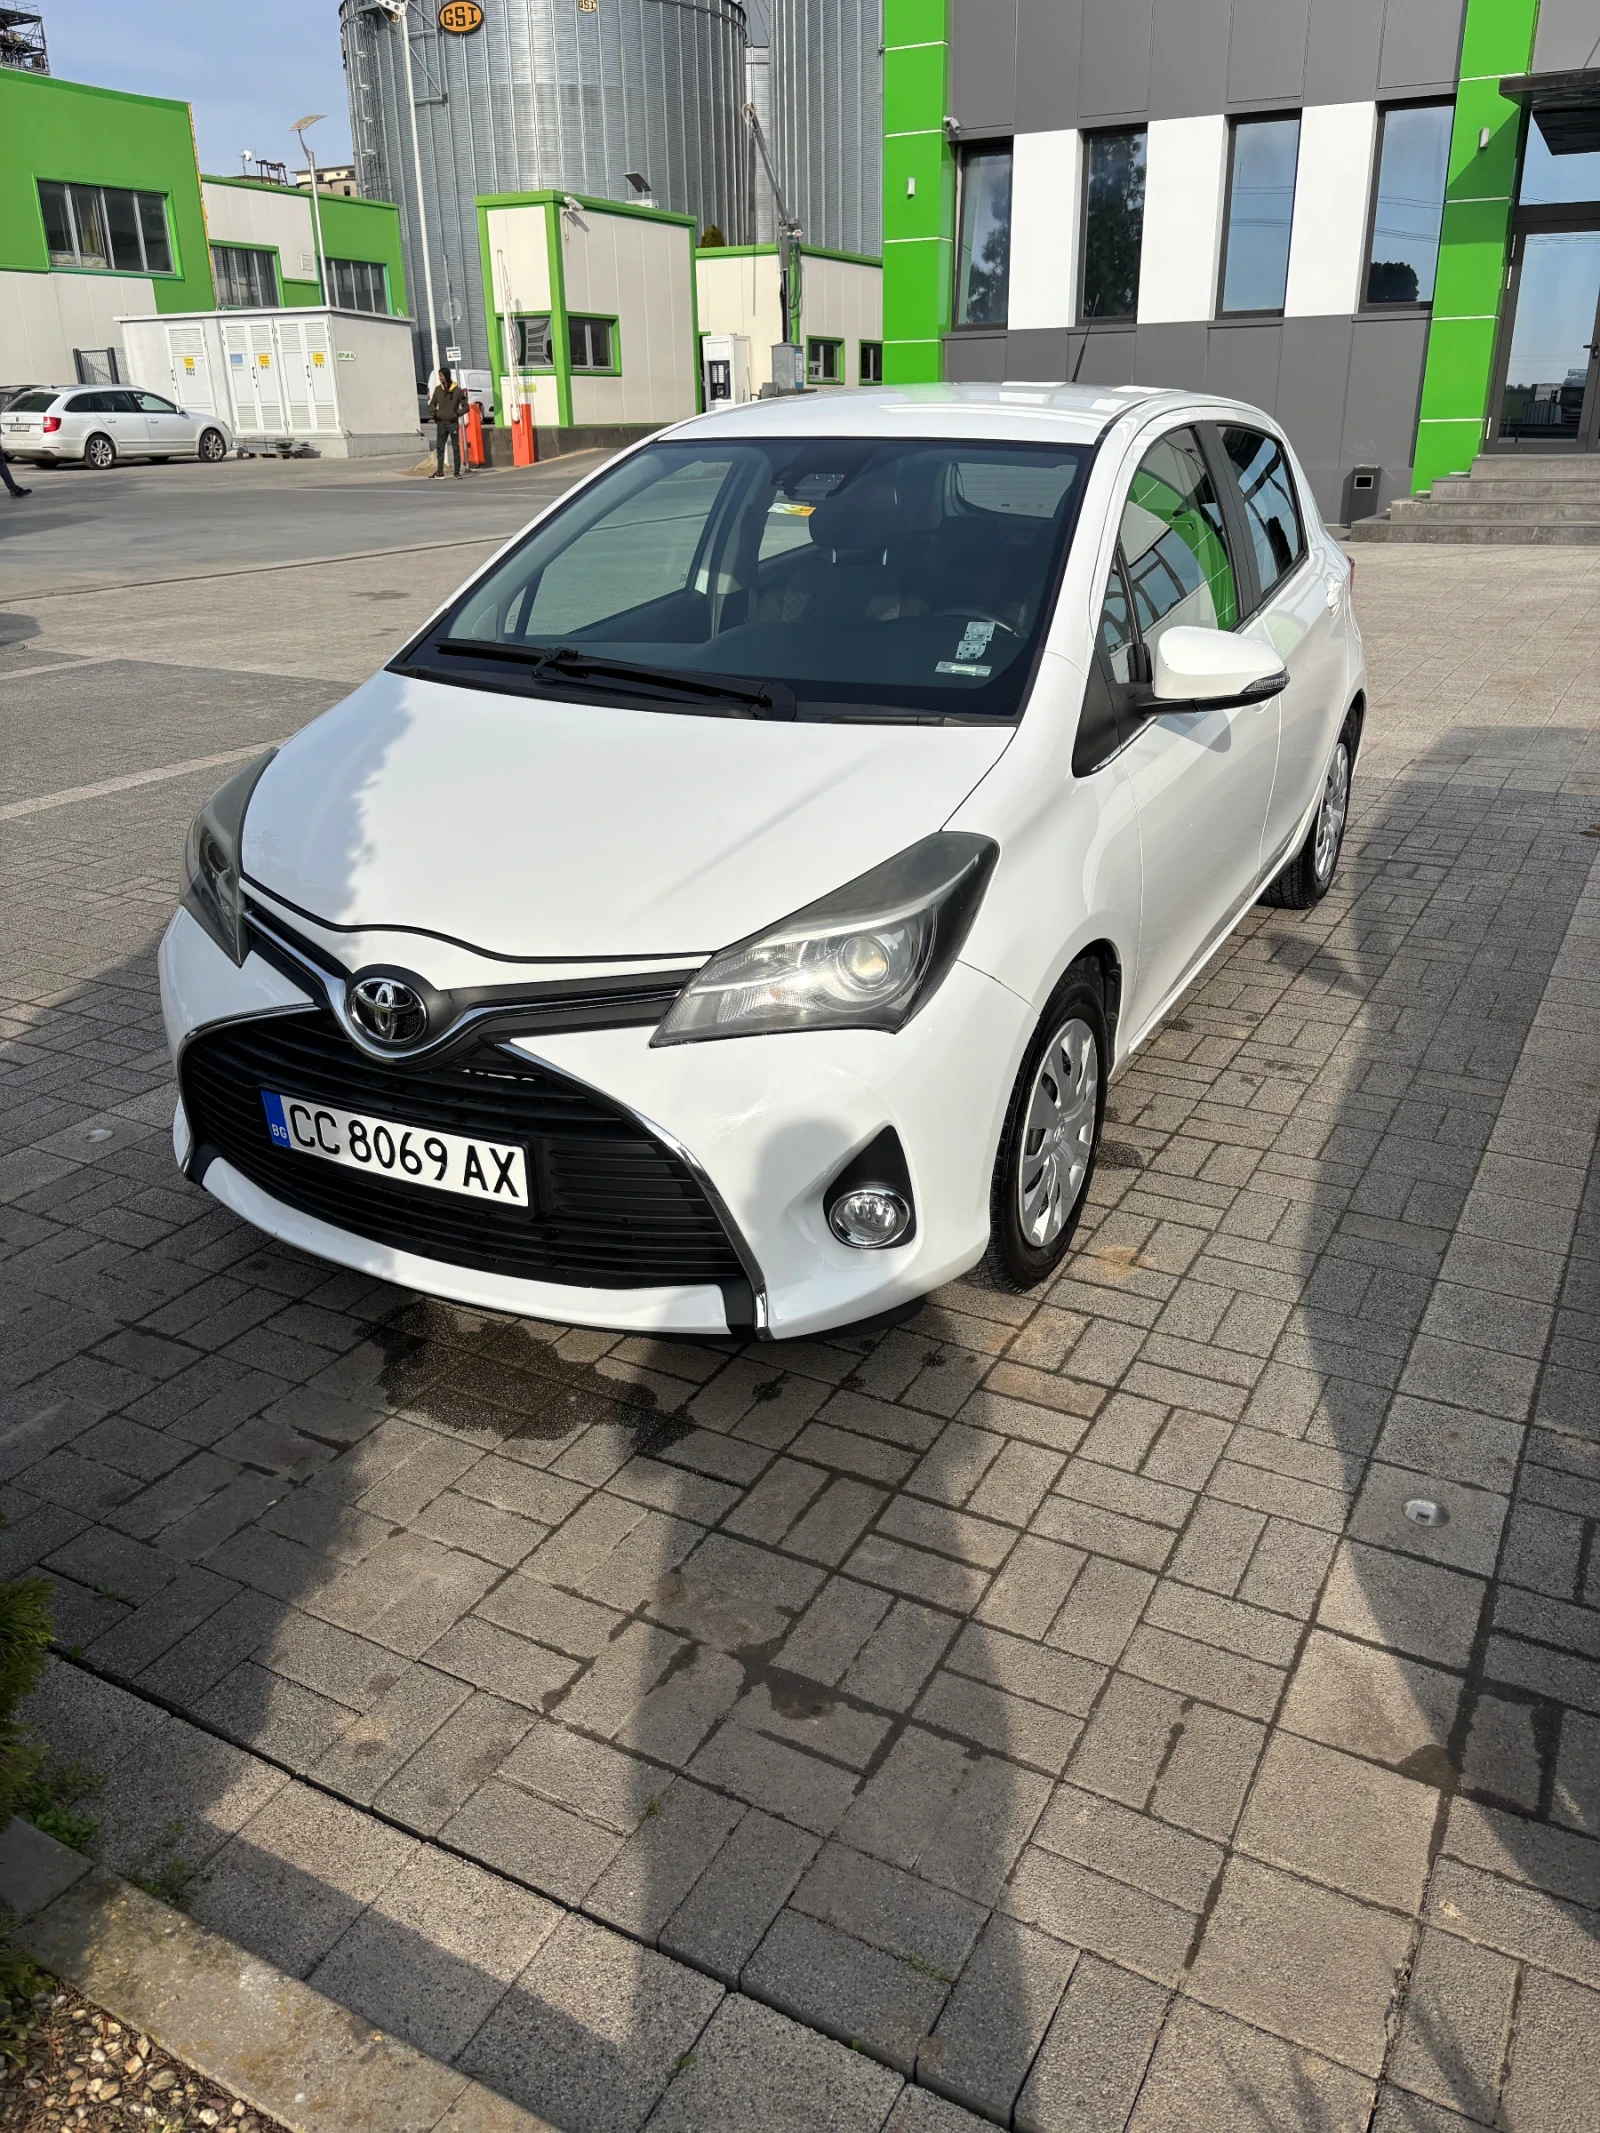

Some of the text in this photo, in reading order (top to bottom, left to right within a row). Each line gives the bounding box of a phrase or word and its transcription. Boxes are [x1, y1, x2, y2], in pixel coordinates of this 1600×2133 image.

[578, 0, 595, 9] GSI
[443, 6, 478, 27] GSI
[272, 1123, 287, 1139] BG
[289, 1104, 520, 1198] CC 8069 AX
